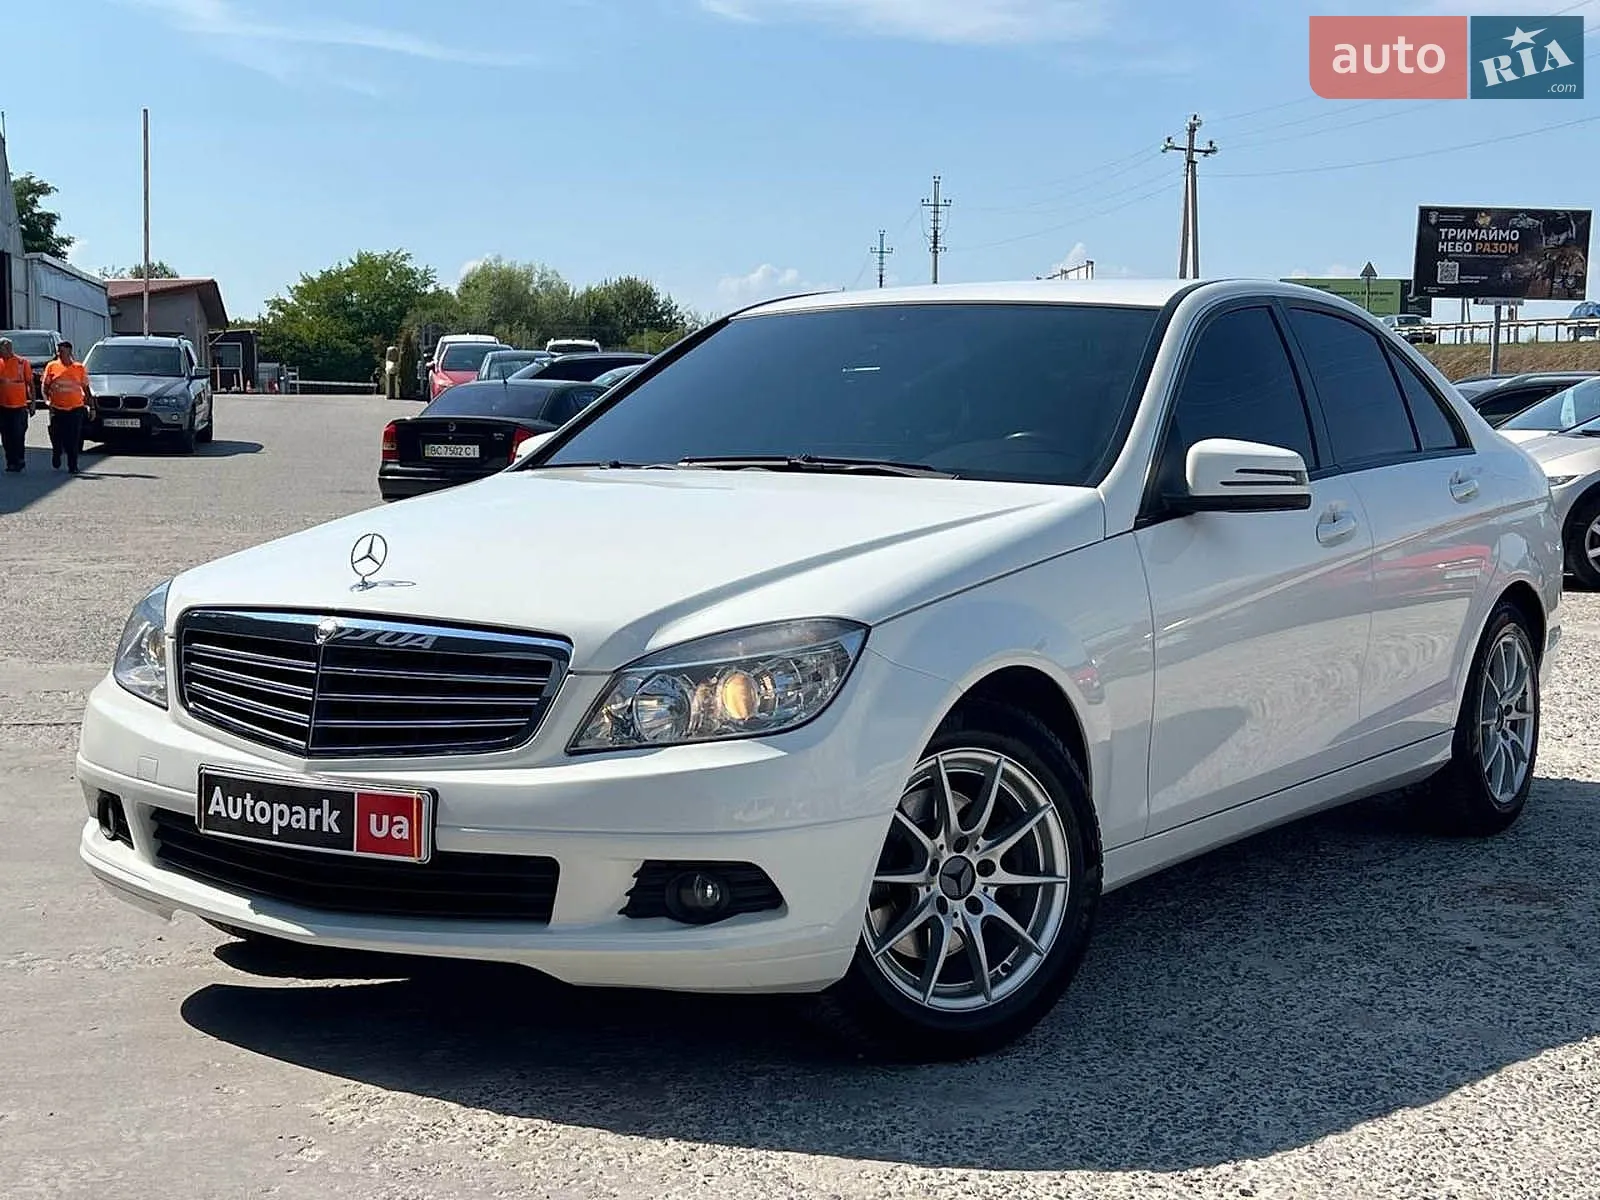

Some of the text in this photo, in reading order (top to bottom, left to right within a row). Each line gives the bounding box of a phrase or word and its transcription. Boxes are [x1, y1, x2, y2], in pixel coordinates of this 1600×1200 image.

[1439, 227, 1520, 241] ТРИМАЙМО
[1438, 241, 1519, 254] НЕБО РАЗОМ
[207, 786, 410, 840] Autopark ua
